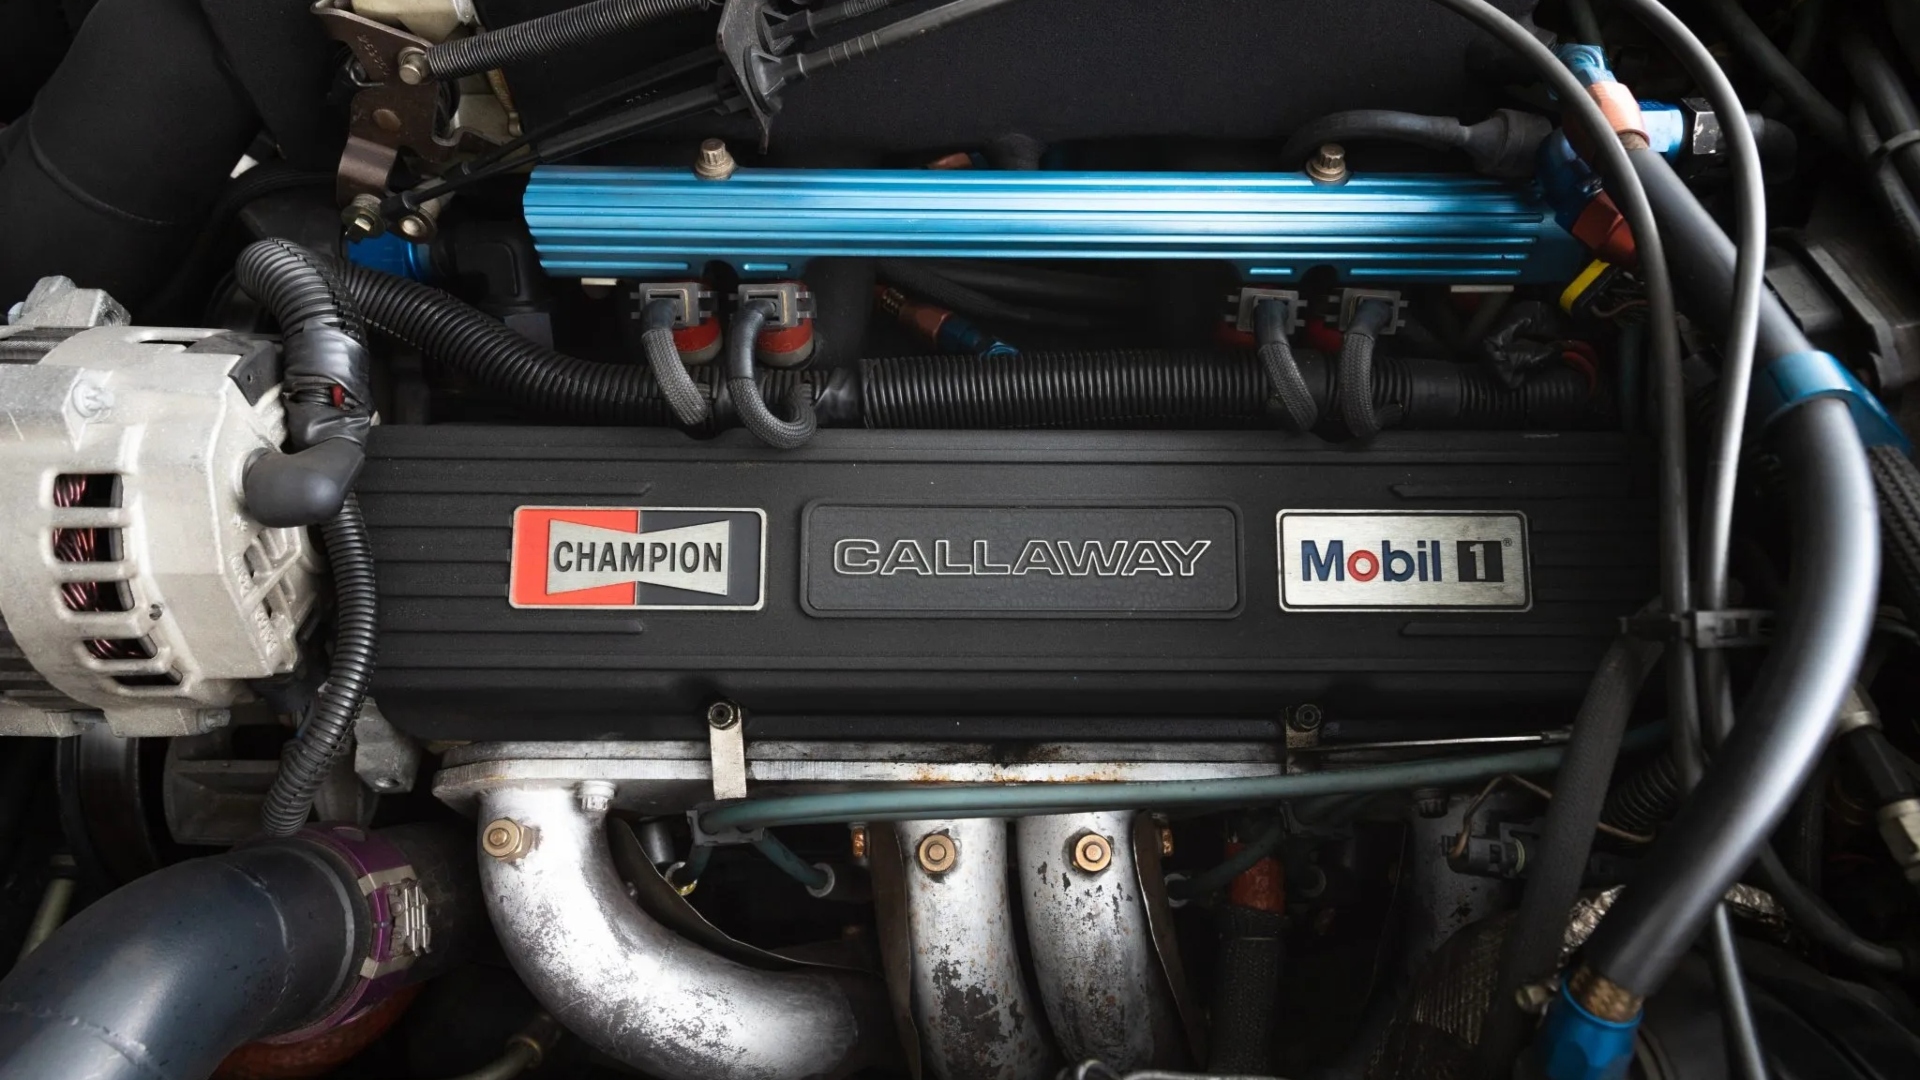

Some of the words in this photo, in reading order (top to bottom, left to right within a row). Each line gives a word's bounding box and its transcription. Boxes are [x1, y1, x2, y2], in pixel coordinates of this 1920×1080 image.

[553, 541, 722, 574] CHAMPION
[833, 539, 1212, 576] CALLAWAY
[1301, 540, 1443, 582] Mobil
